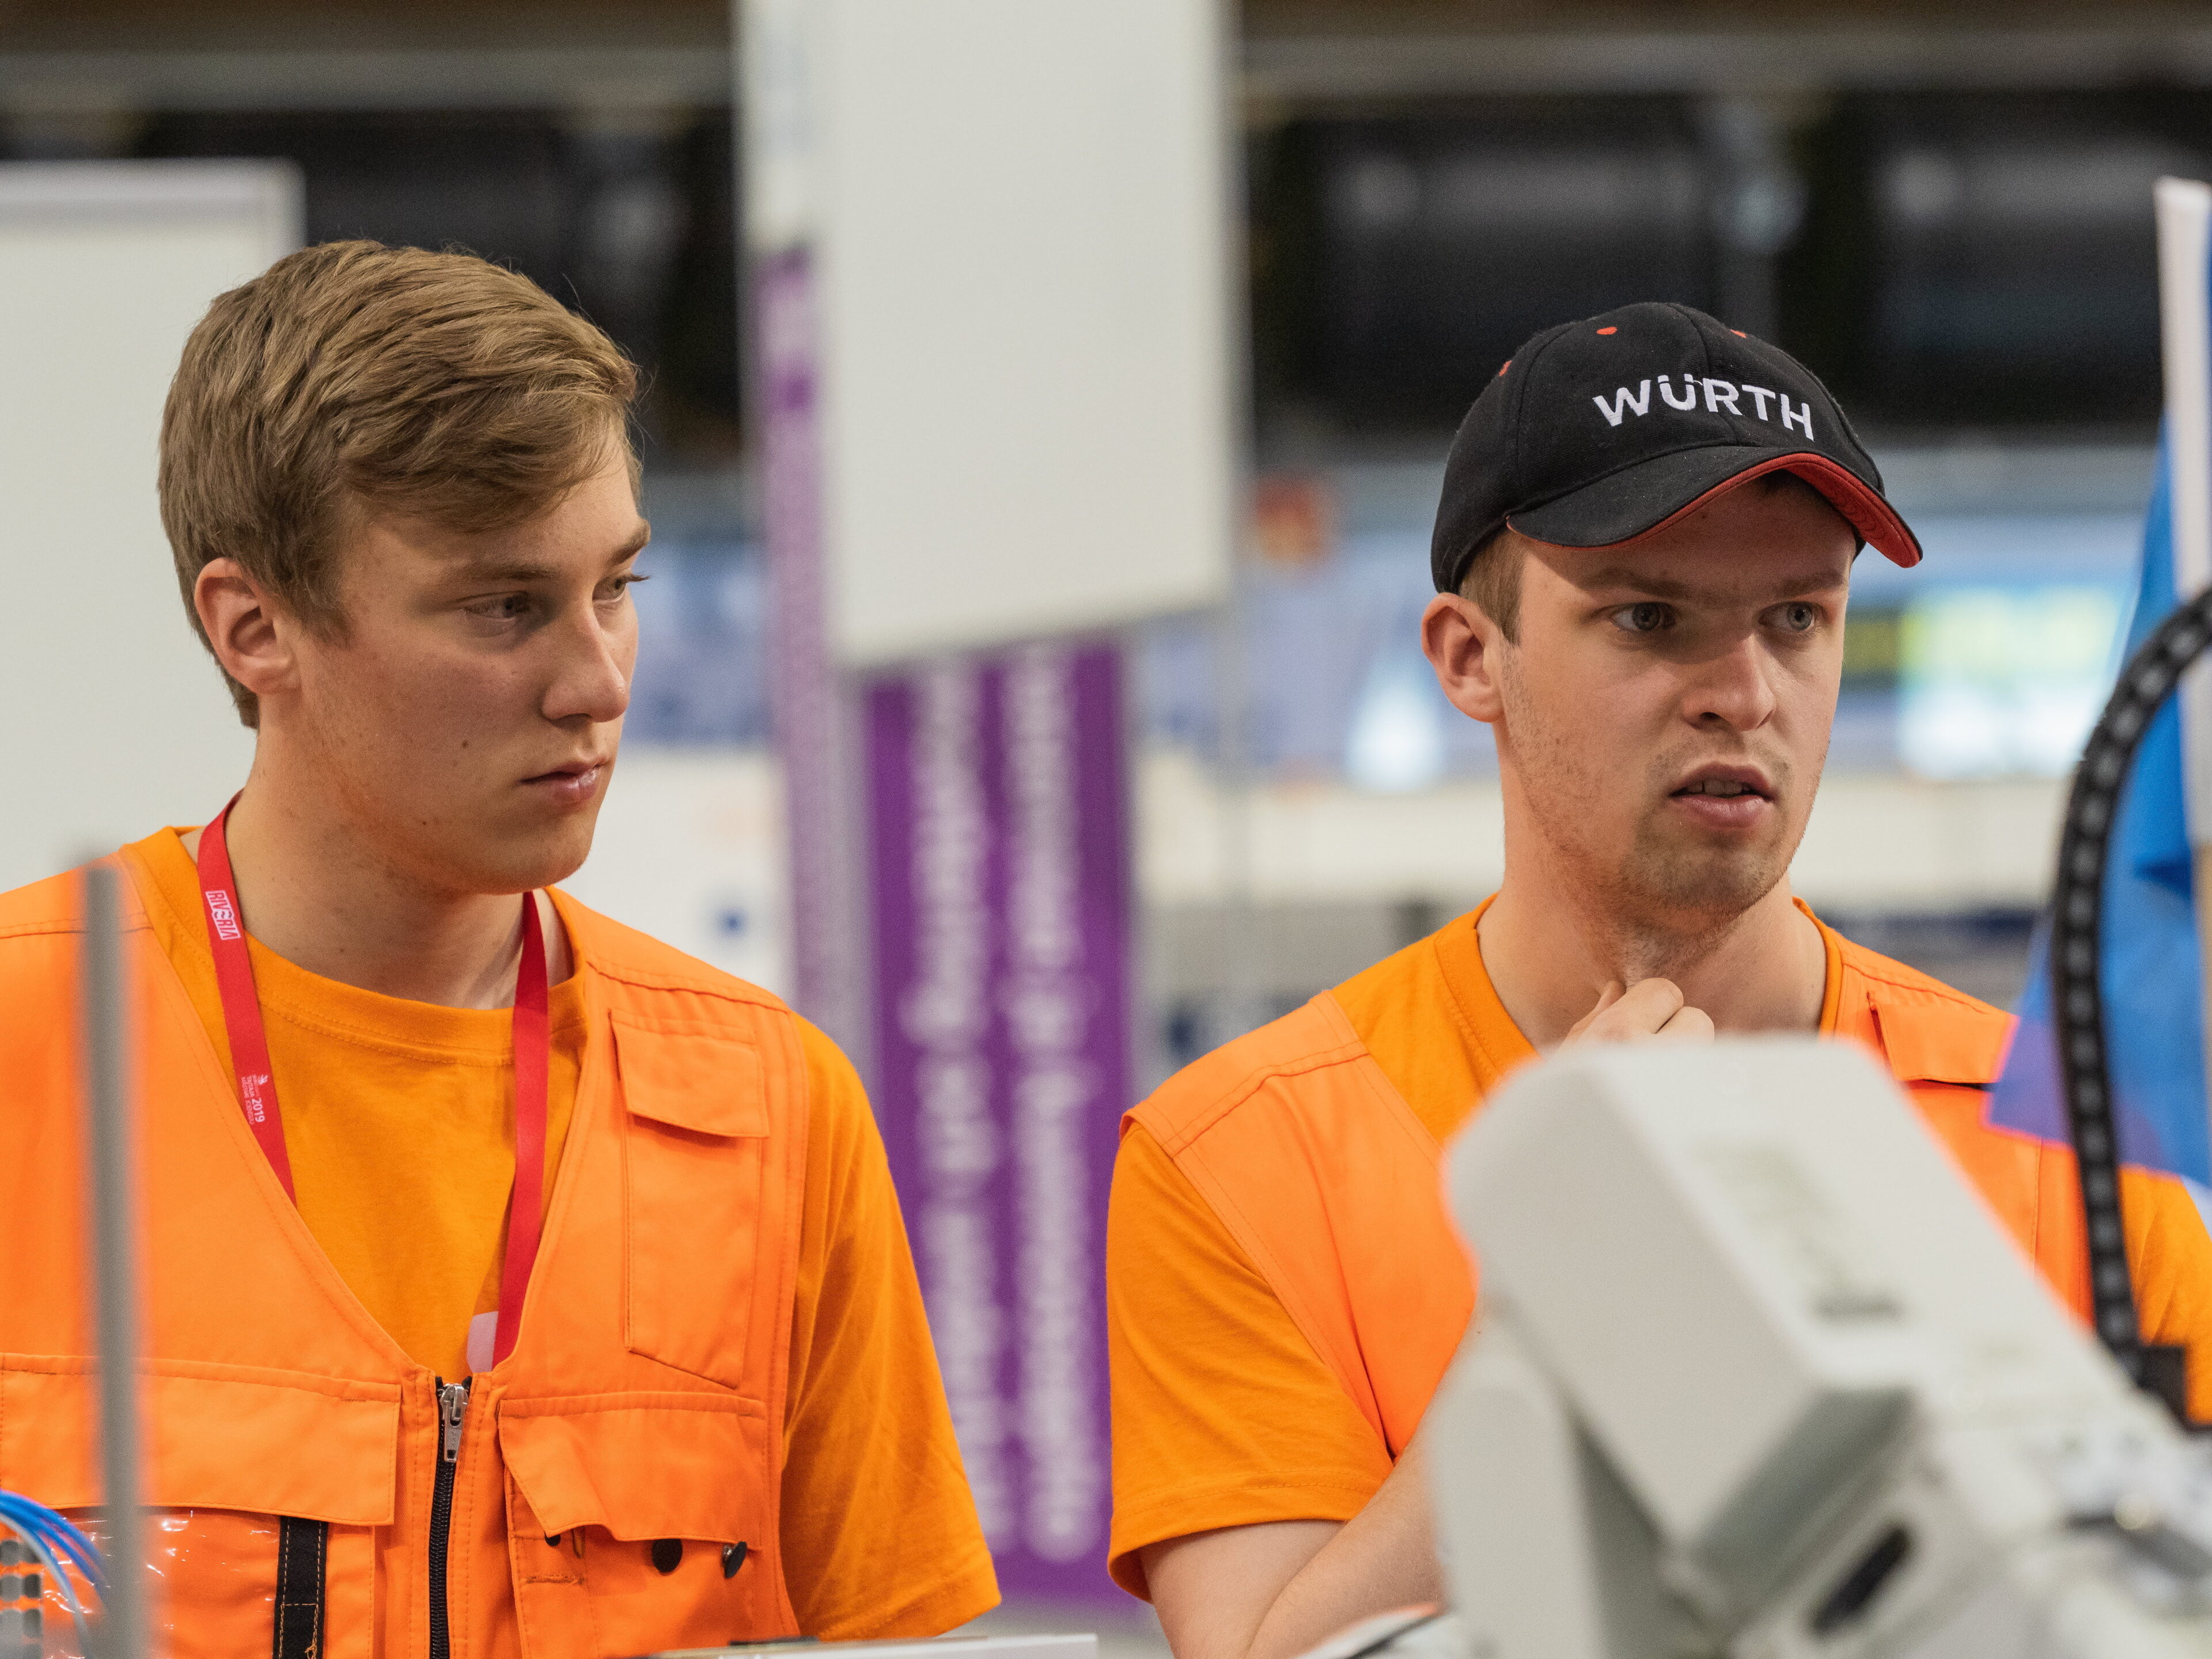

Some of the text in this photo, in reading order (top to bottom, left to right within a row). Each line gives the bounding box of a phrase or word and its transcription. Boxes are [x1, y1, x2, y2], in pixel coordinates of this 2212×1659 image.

[1592, 373, 1815, 442] WÜRTH
[207, 891, 239, 940] RIVERIA
[251, 1097, 265, 1123] 2019
